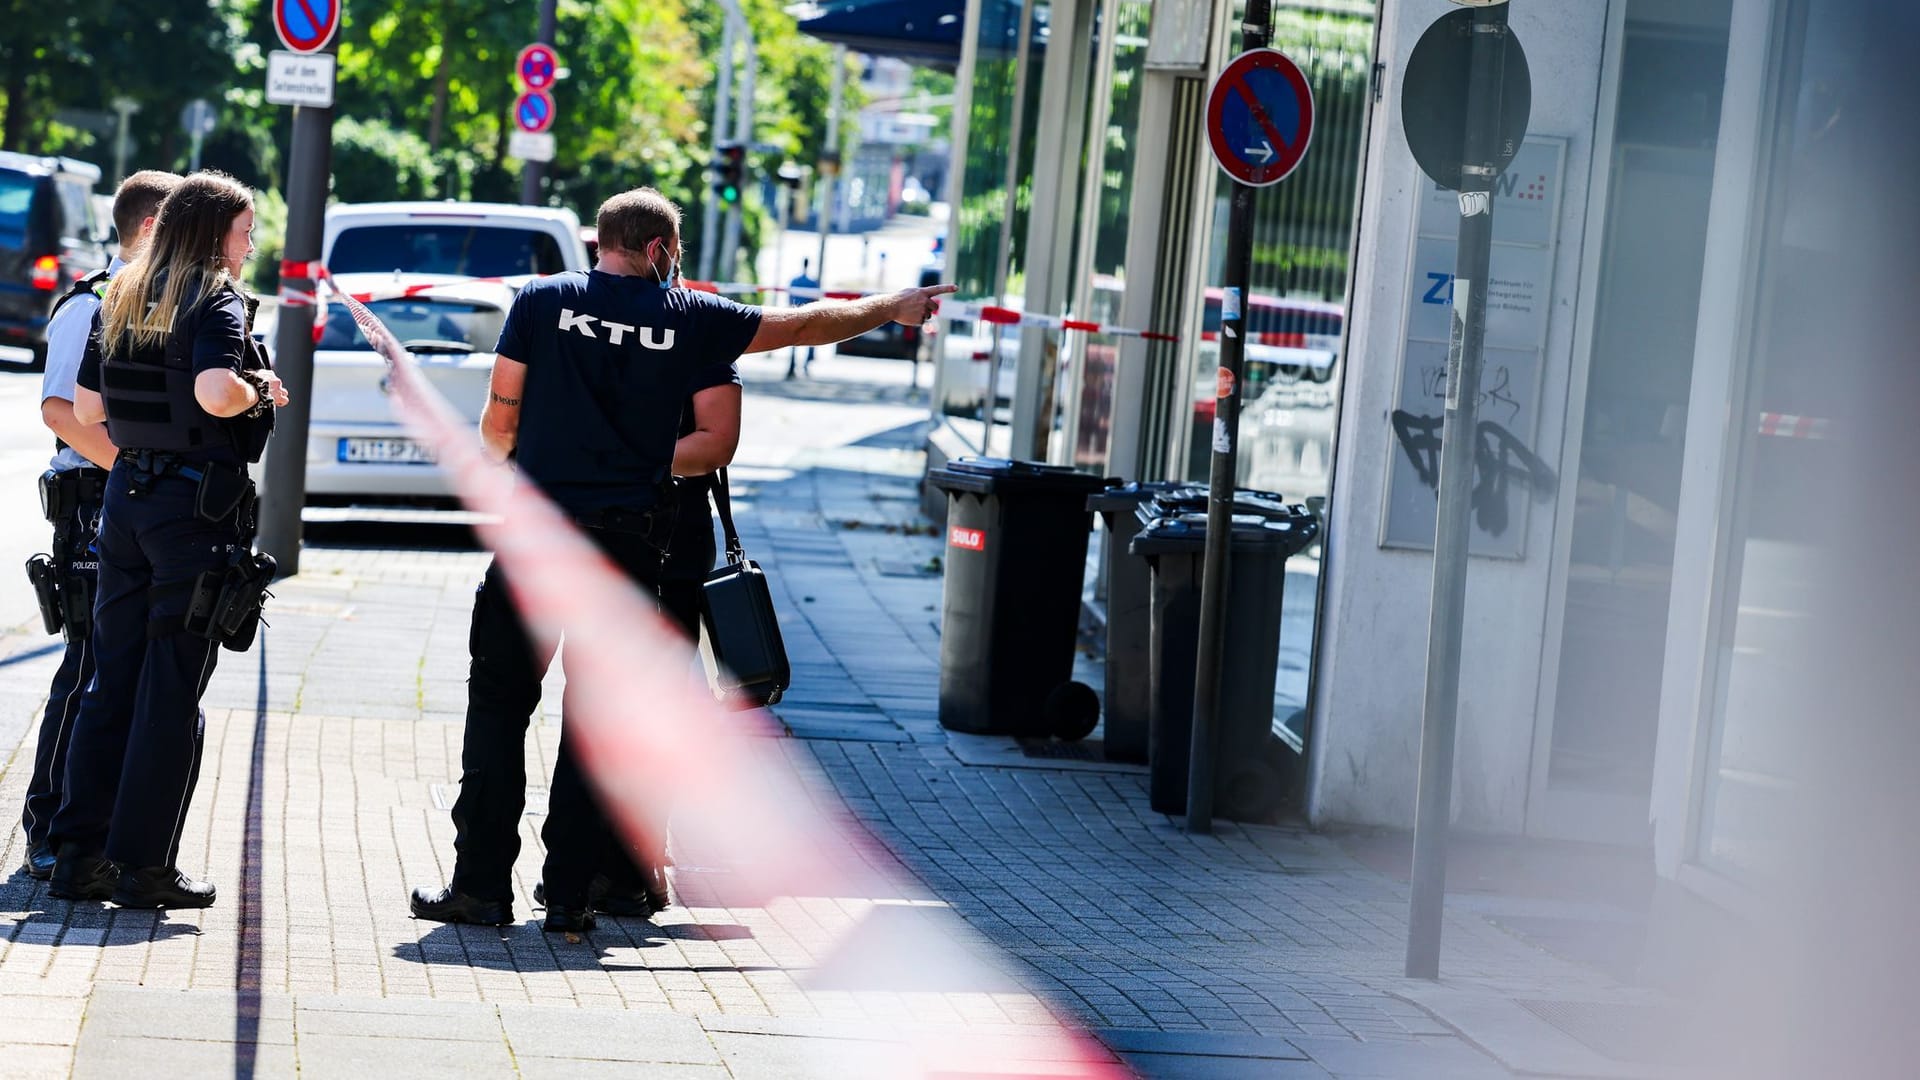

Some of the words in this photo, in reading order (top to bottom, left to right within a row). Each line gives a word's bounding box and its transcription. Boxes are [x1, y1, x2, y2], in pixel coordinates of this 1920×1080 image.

[1489, 278, 1521, 288] Zentrum
[1487, 290, 1532, 300] Integration
[1503, 303, 1531, 313] Bildung
[559, 308, 675, 350] KTU
[953, 530, 979, 546] SULO
[73, 561, 99, 570] POLIZEI
